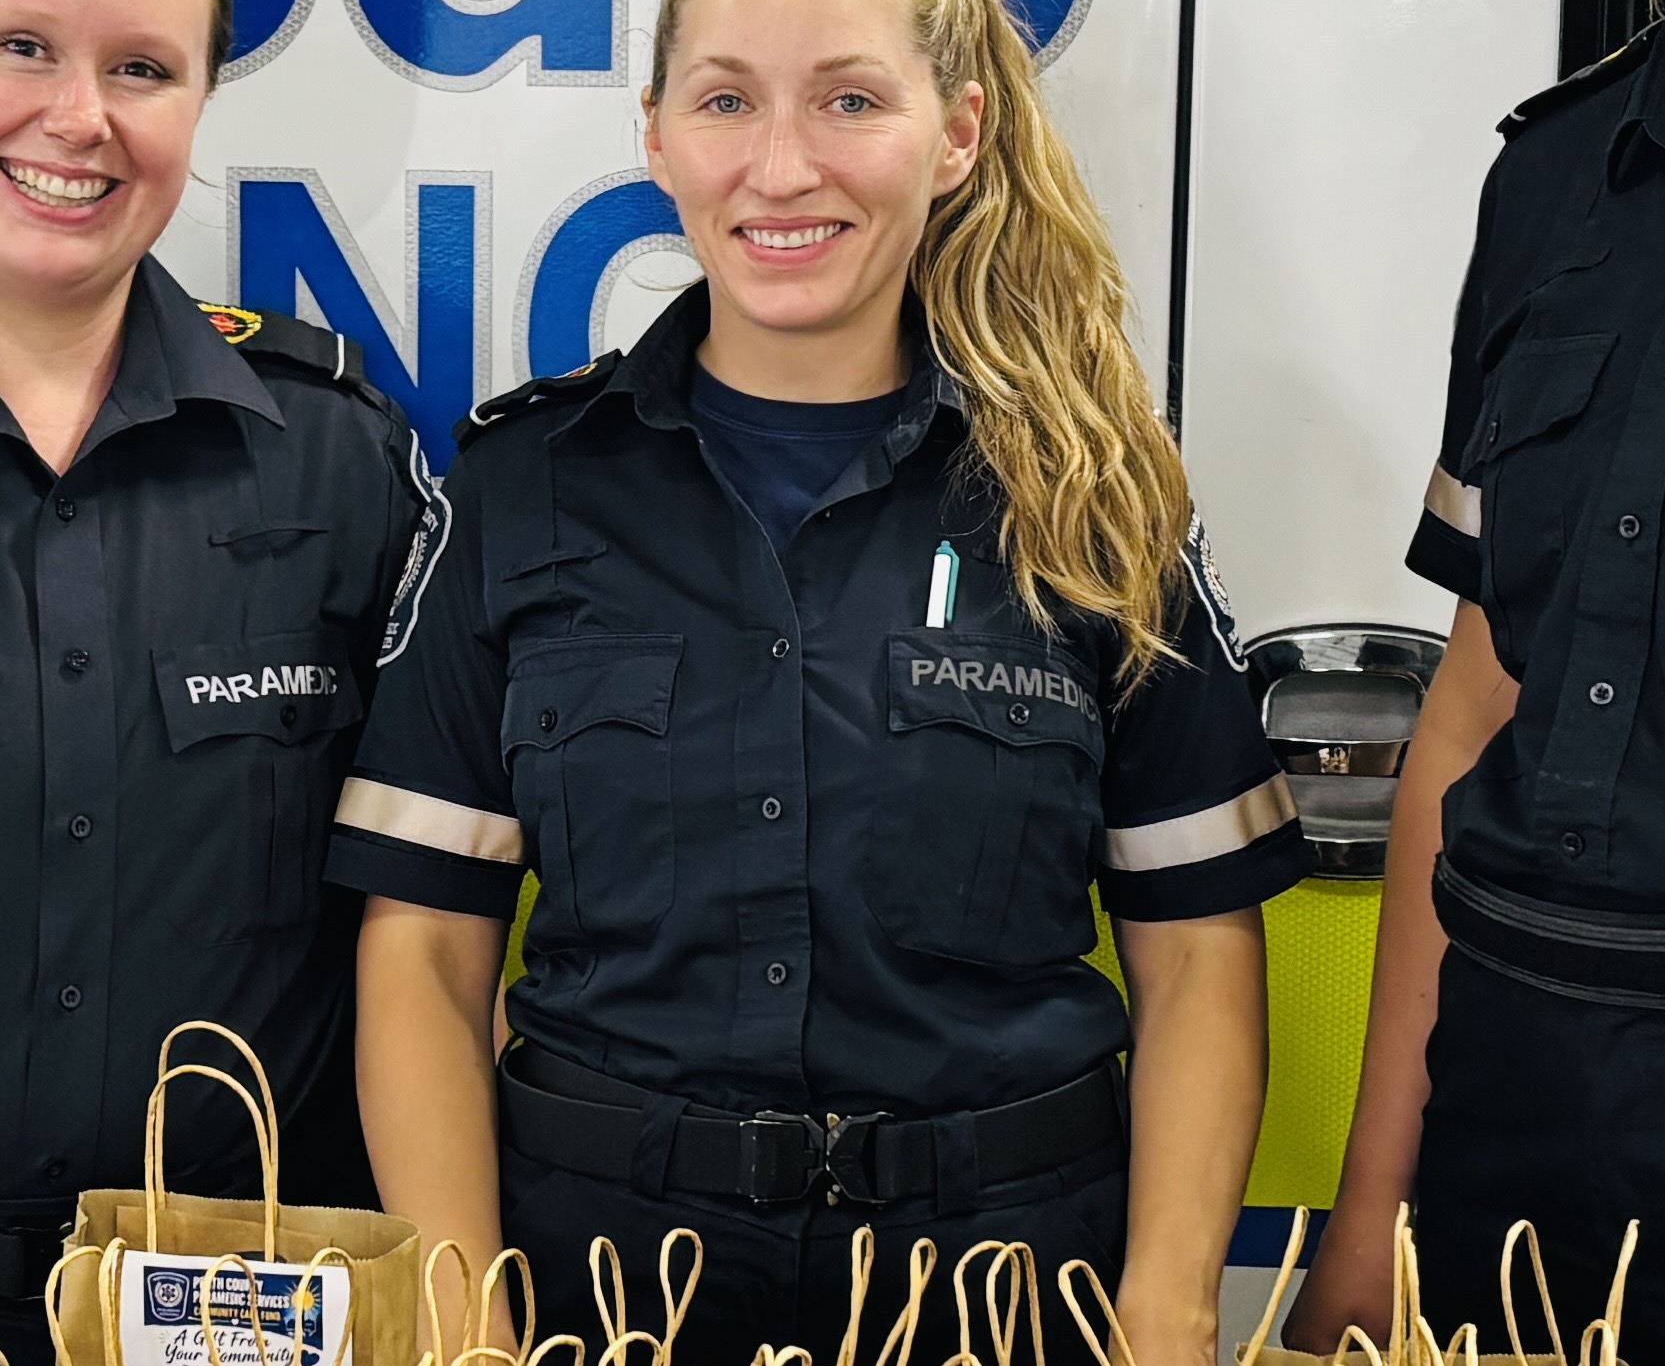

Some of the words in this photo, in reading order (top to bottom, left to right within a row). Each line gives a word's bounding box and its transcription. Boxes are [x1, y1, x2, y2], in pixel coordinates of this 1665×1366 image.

[186, 665, 337, 704] PARAMEDIC
[912, 657, 1097, 722] PARAMEDIC
[193, 1276, 224, 1290] PTH
[174, 1329, 187, 1346] A
[165, 1344, 203, 1364] Your
